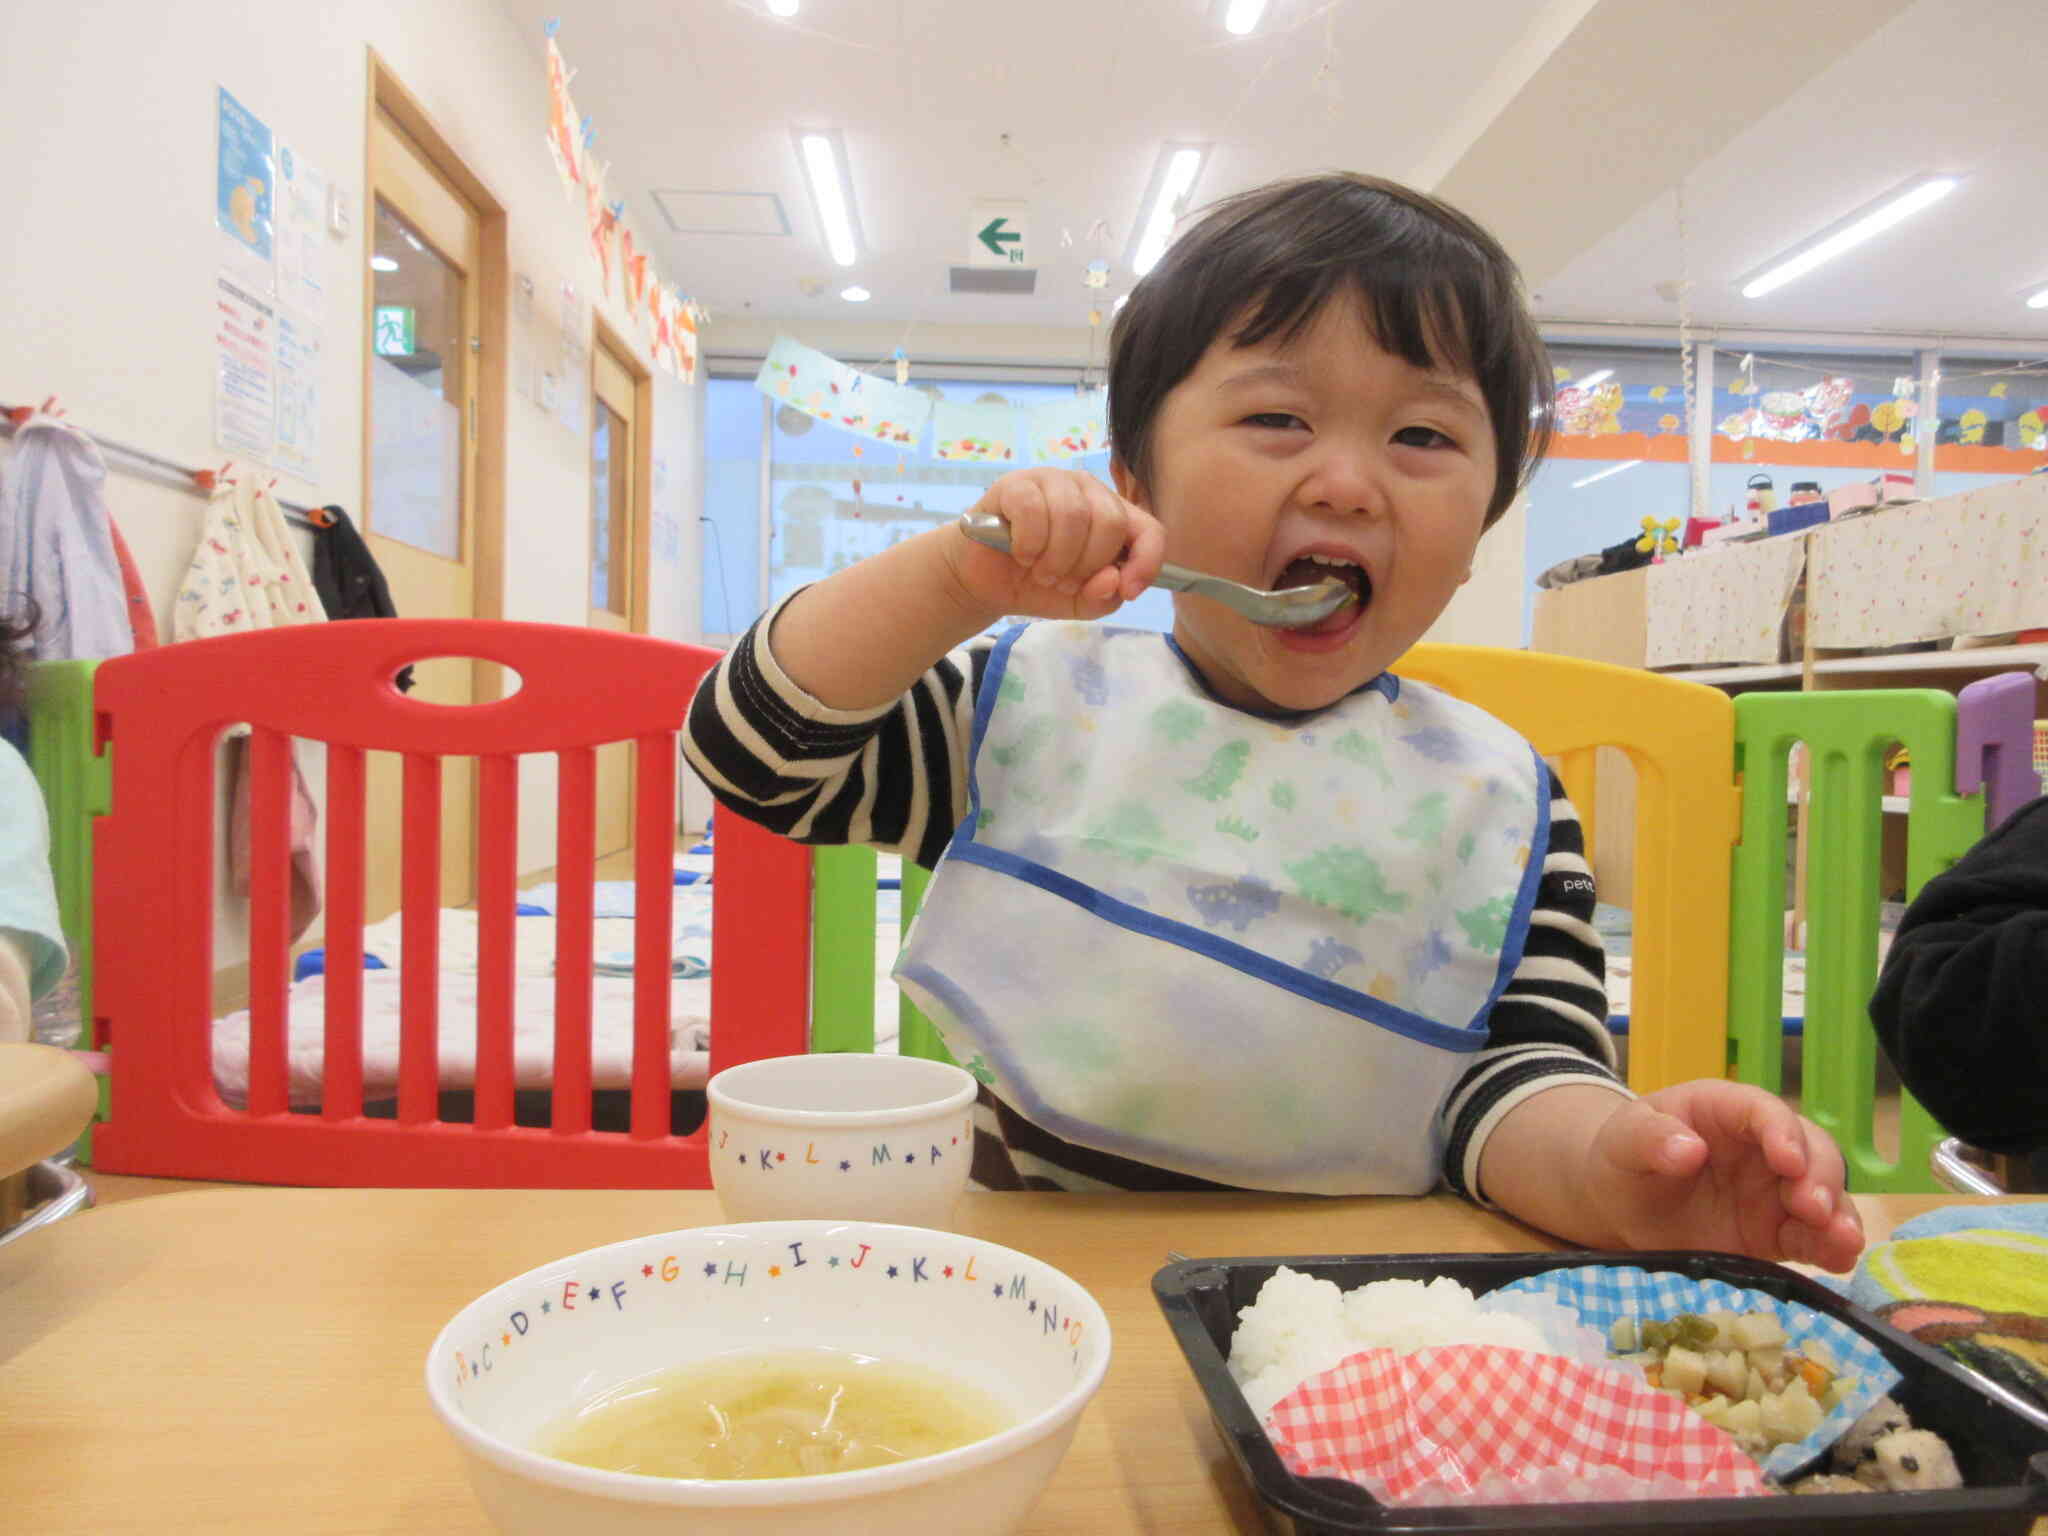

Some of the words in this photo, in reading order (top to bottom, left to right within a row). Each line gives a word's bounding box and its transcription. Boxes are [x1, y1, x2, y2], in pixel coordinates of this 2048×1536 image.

[760, 1150, 774, 1171] K
[806, 1143, 820, 1164] L
[872, 1143, 892, 1166] M
[482, 1343, 493, 1371] C
[510, 1312, 529, 1335] D
[563, 1281, 580, 1310] E
[611, 1281, 627, 1311] F
[661, 1256, 680, 1282] G
[724, 1260, 748, 1287] H
[788, 1242, 807, 1267] I
[850, 1243, 872, 1268] J
[912, 1257, 929, 1282] K
[964, 1256, 977, 1281] L
[1008, 1274, 1026, 1300] M
[1043, 1304, 1057, 1335] N
